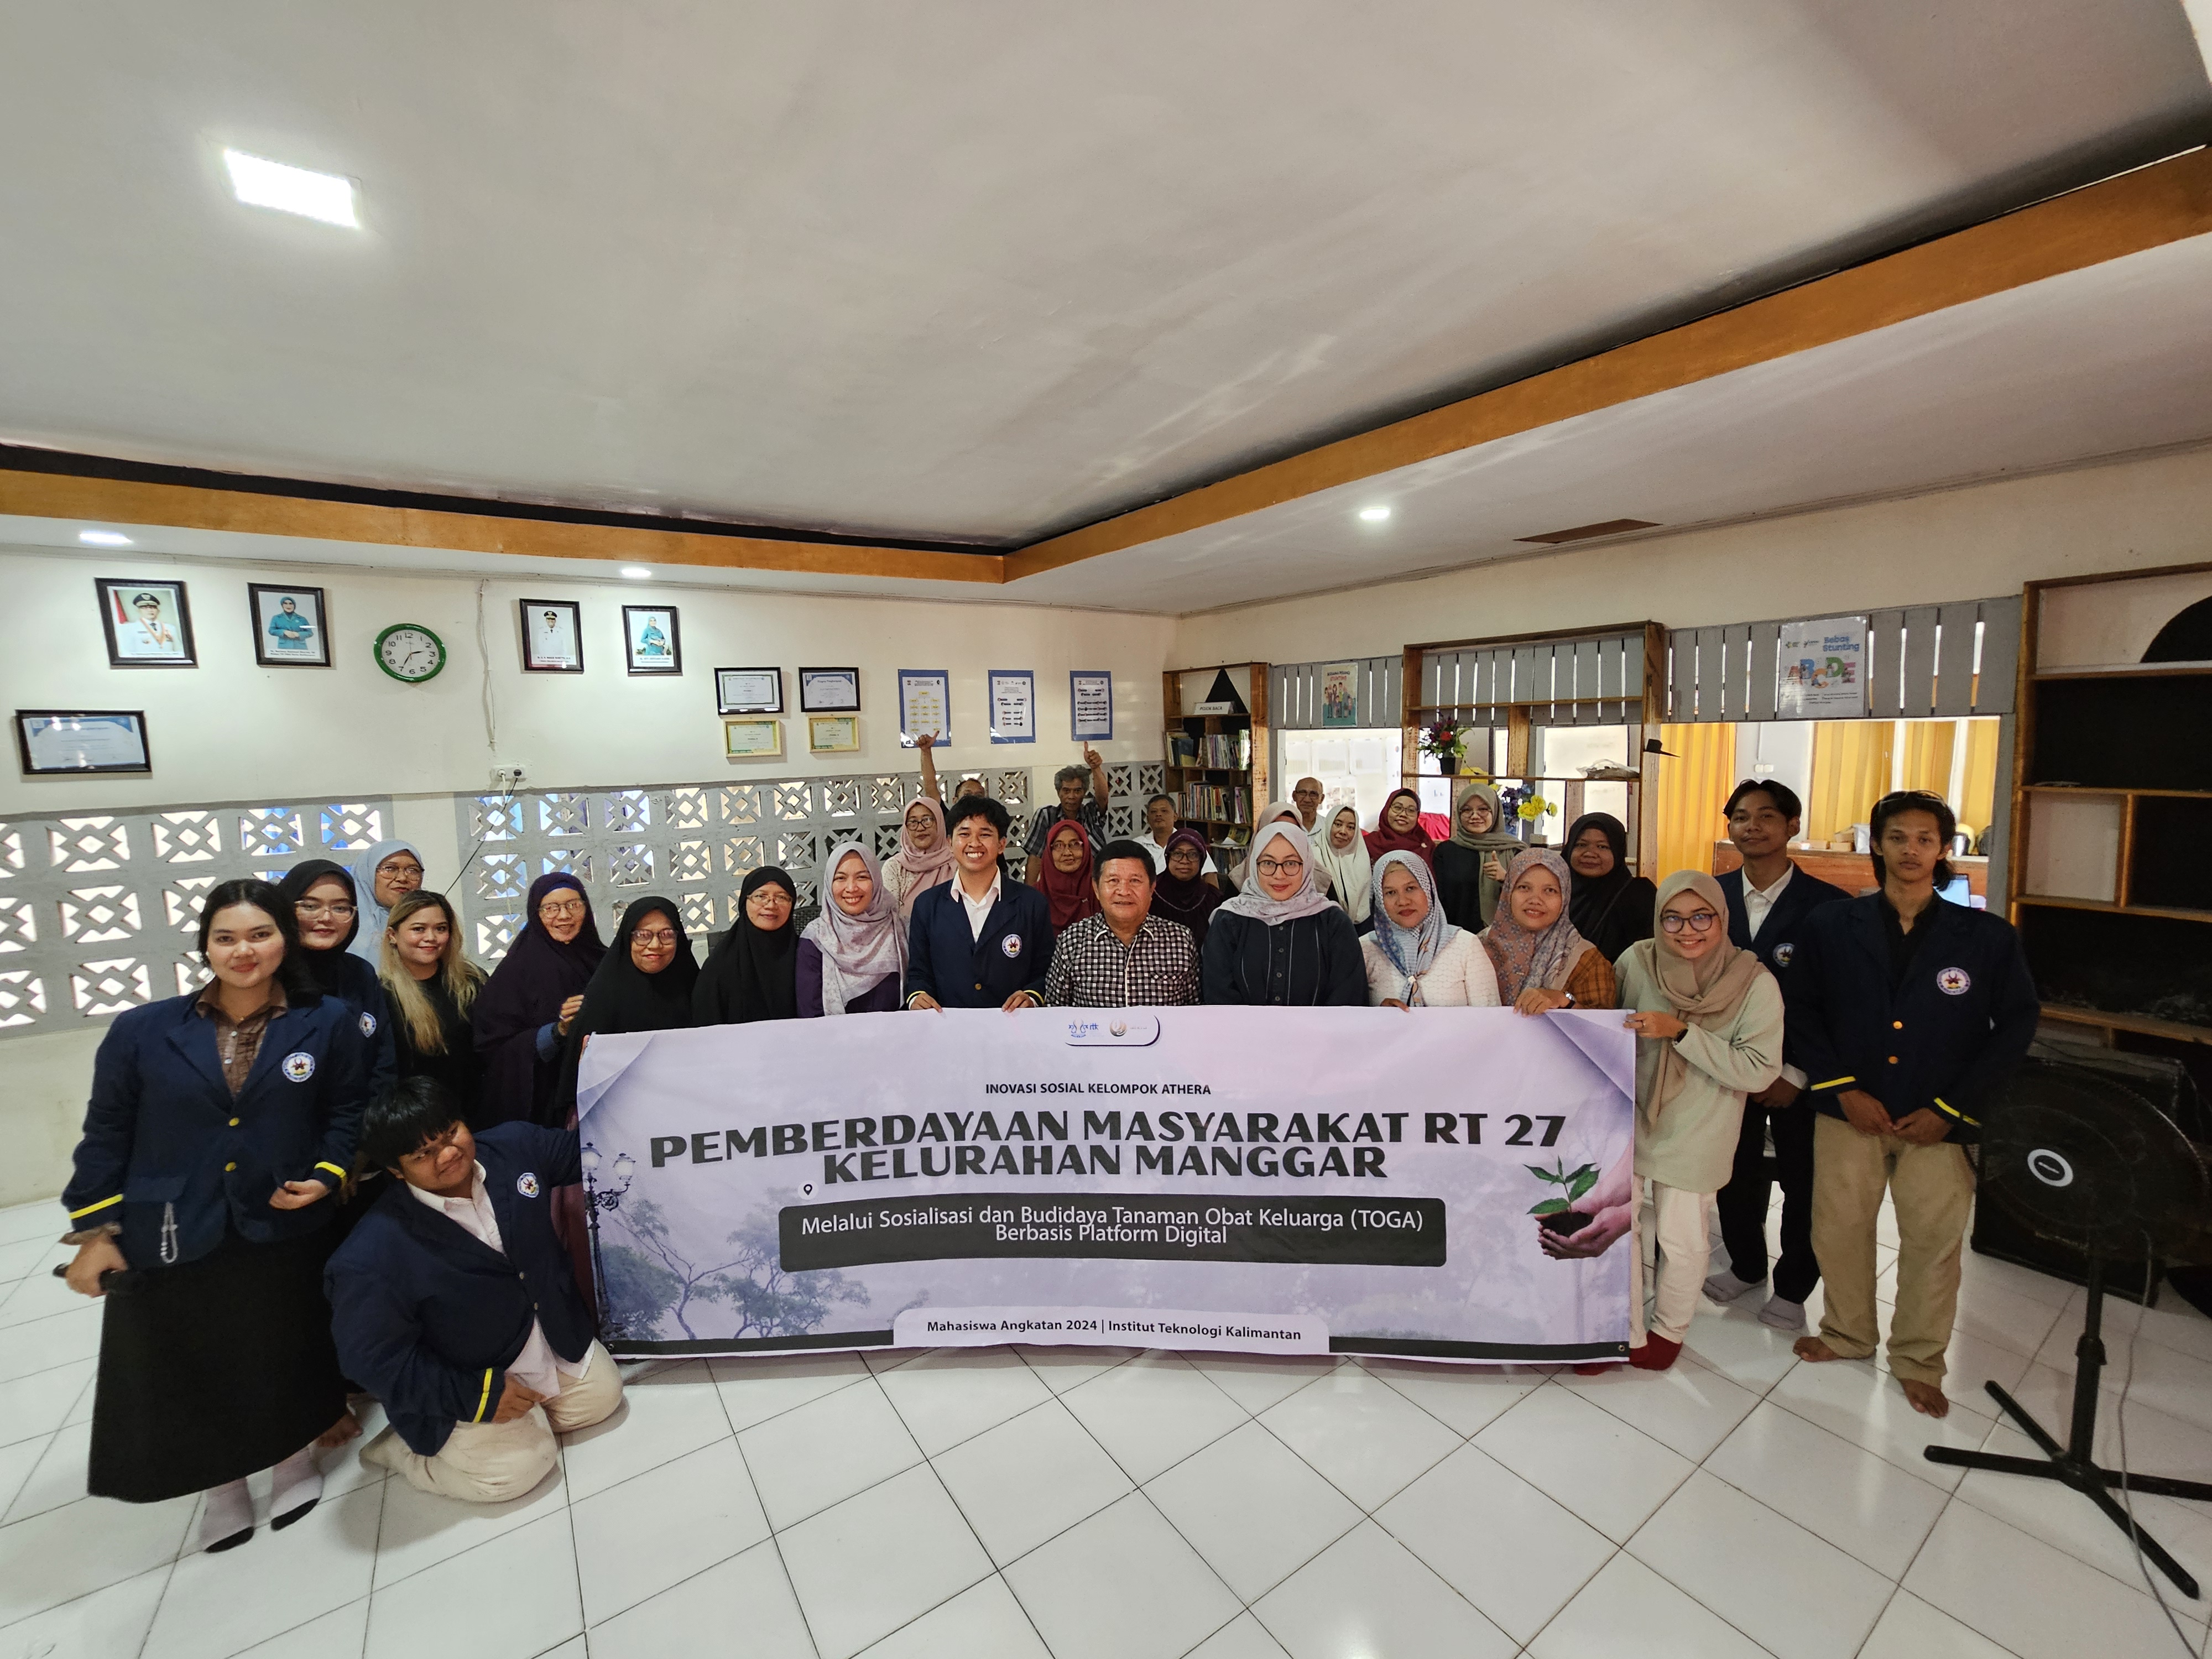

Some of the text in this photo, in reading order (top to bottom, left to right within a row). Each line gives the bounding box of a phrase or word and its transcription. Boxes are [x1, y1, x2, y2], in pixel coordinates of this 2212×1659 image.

[1823, 643, 1860, 651] Stunting
[1824, 635, 1850, 644] Bebas
[986, 1082, 1211, 1095] INOVASI SOSIAL KELOMPOK ATHERA
[650, 1110, 1566, 1168] PEMBERDAYAAN MASYARAKAT RT 27
[824, 1145, 1387, 1185] KELURAHAN MANGGAR
[802, 1206, 1423, 1235] Melalui Sosialisasi dan Budidaya Tanaman Obat Keluarga (TOGA)
[996, 1224, 1227, 1246] Berbasis Platform Digital
[927, 1321, 997, 1332] Mahasiswa
[1000, 1320, 1062, 1332] Angkatan
[1066, 1320, 1097, 1331] 2024
[1109, 1321, 1155, 1333] Institut
[1158, 1323, 1222, 1338] Teknologi
[1226, 1326, 1301, 1340] Kalimantan
